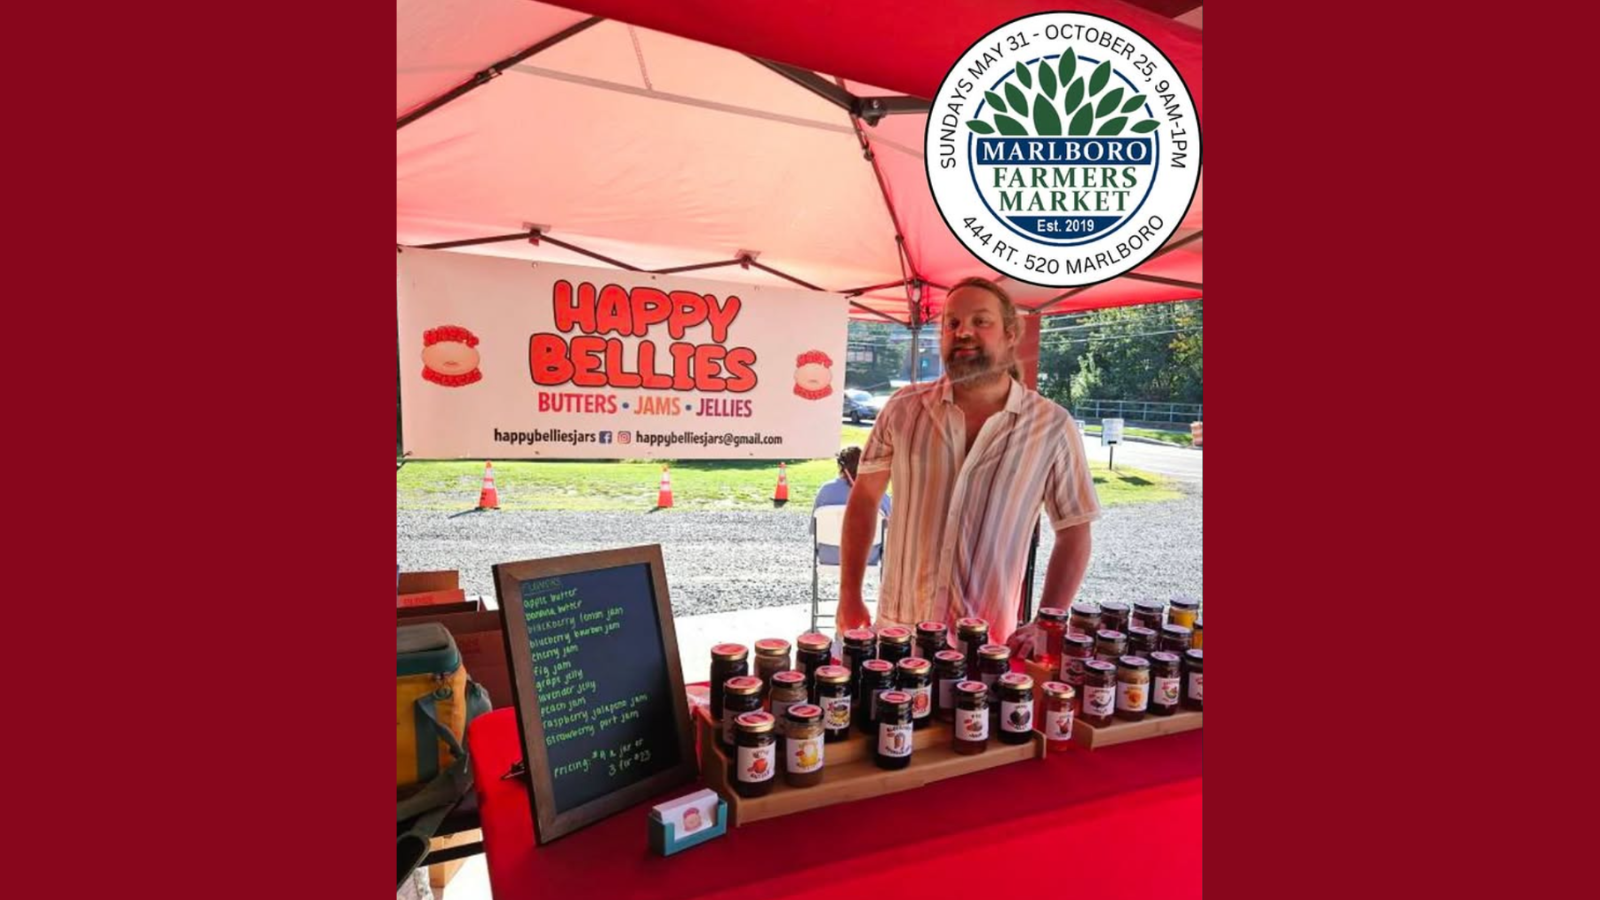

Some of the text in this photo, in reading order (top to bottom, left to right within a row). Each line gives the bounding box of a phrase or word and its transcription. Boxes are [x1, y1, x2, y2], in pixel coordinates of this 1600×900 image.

[552, 279, 742, 344] HAPPY
[528, 331, 758, 393] BELLIES
[538, 391, 753, 418] BUTTERS JAMS JELLIES
[493, 428, 783, 448] happybelliesjars happybelliesjars@gmail.com
[606, 607, 624, 621] jam
[604, 622, 620, 635] jam
[562, 644, 579, 658] jam
[533, 660, 571, 678] fig jam
[543, 710, 589, 729] raspberry
[630, 693, 648, 708] jam
[568, 696, 586, 711] jam
[620, 710, 640, 723] jam
[608, 763, 617, 776] 3
